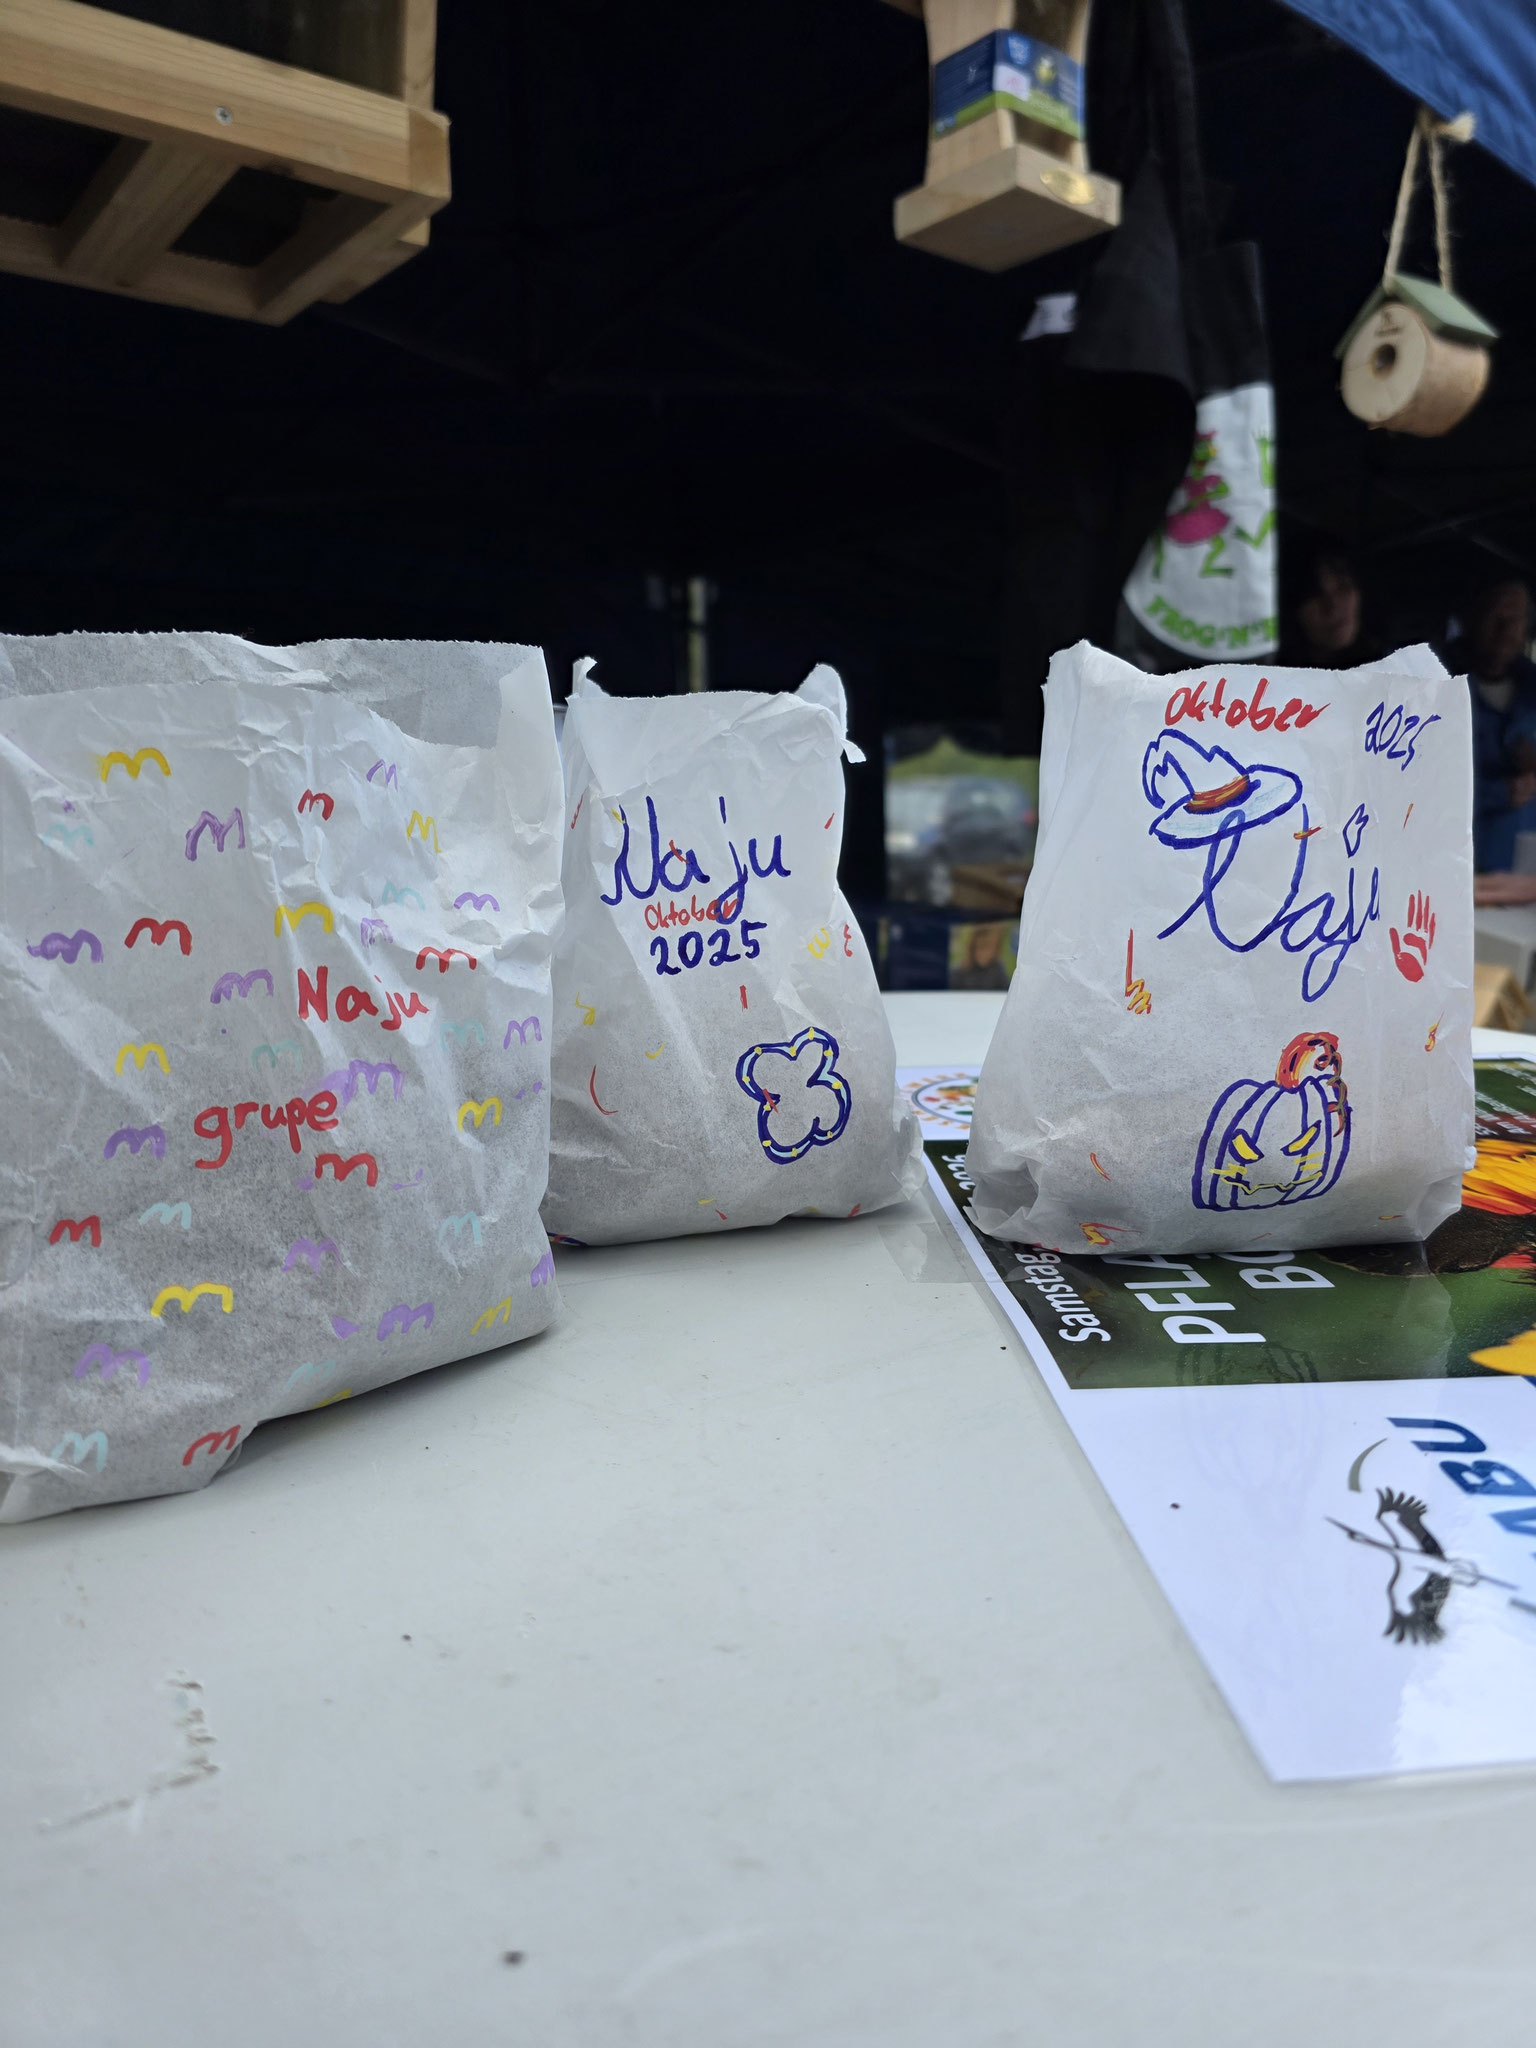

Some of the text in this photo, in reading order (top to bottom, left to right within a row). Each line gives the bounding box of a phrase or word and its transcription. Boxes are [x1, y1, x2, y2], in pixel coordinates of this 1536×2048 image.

[1165, 678, 1331, 732] Oktober
[1365, 701, 1442, 772] 2025
[600, 795, 791, 925] Naju
[644, 895, 738, 931] Oktober
[1157, 803, 1380, 1002] Naju
[650, 919, 767, 976] 2025
[297, 965, 430, 1031] Naju
[194, 1089, 339, 1170] grupe
